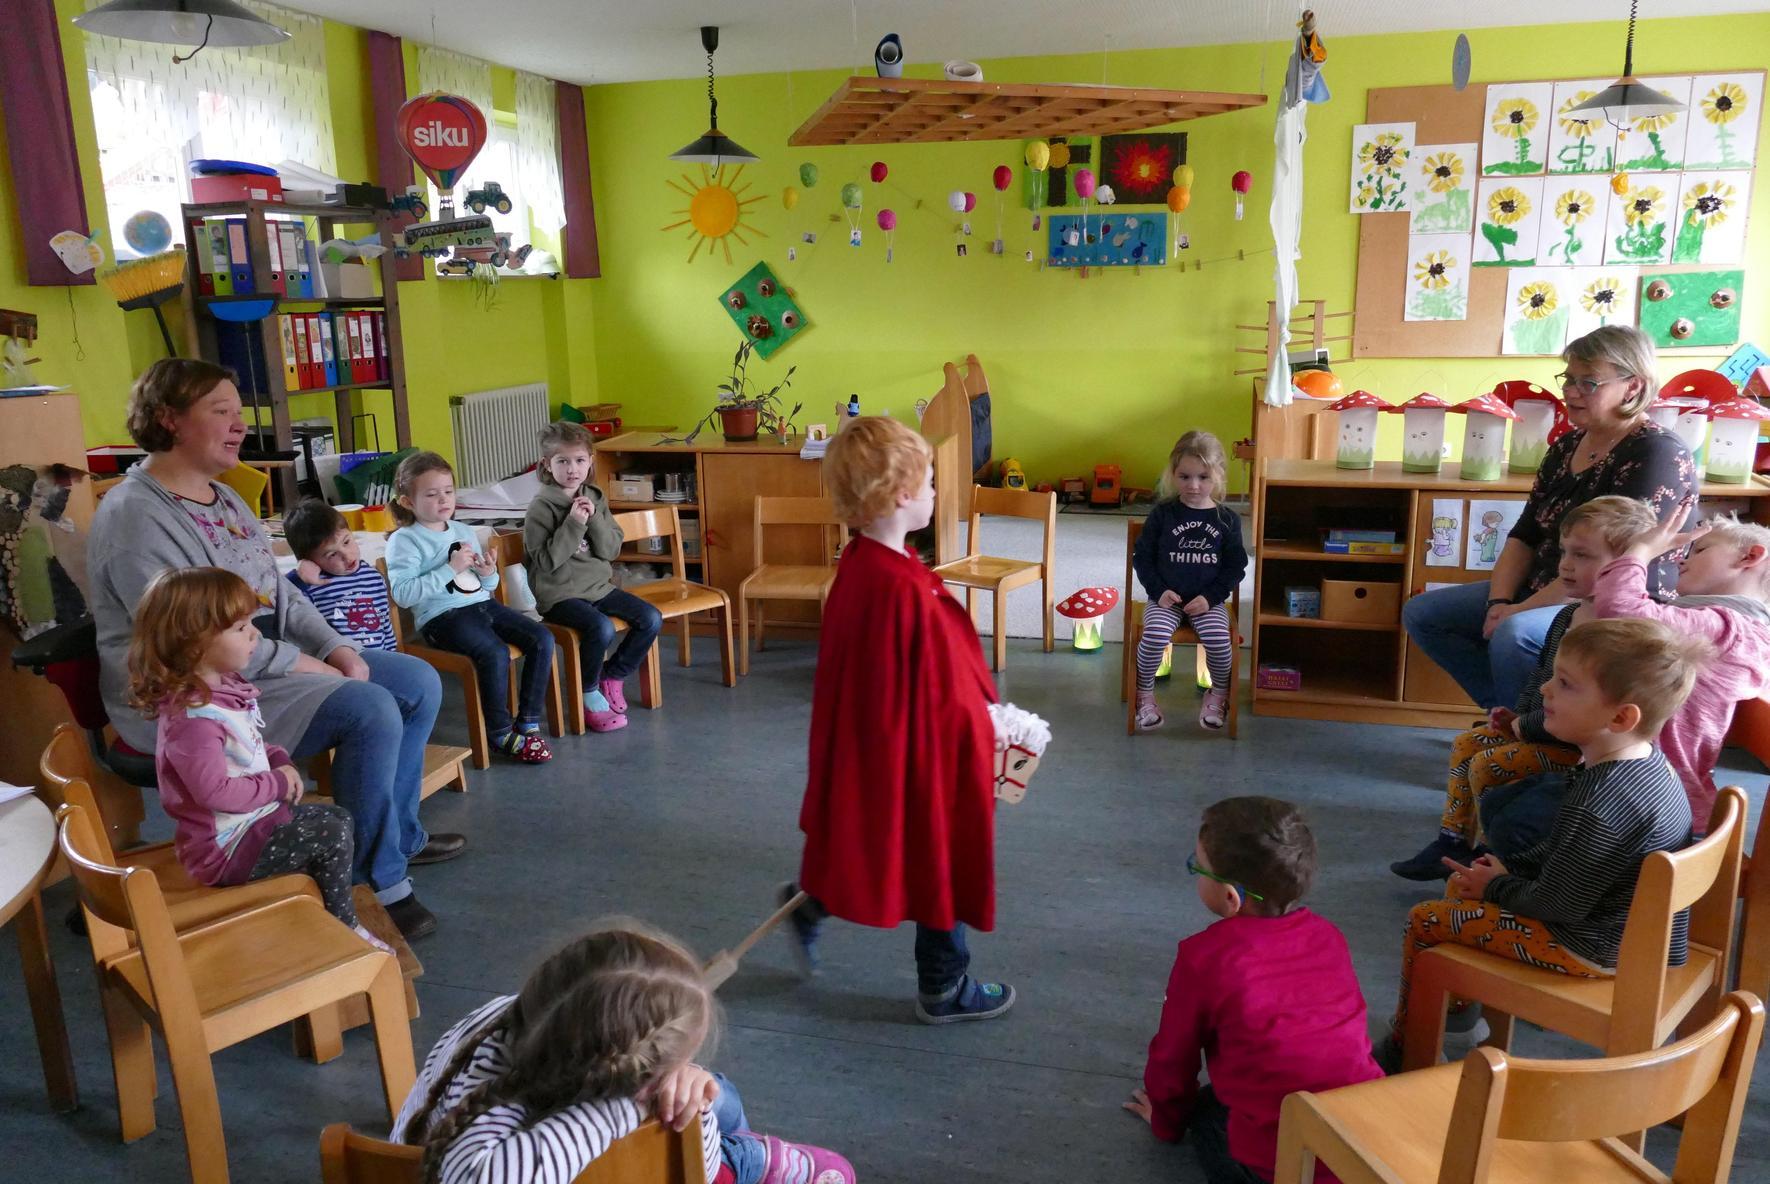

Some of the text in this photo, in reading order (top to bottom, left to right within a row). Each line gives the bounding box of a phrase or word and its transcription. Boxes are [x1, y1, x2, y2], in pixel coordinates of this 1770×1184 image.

[414, 120, 469, 147] siku
[1171, 521, 1220, 538] ENJOY THE
[1178, 536, 1213, 550] little
[1169, 551, 1218, 564] THINGS
